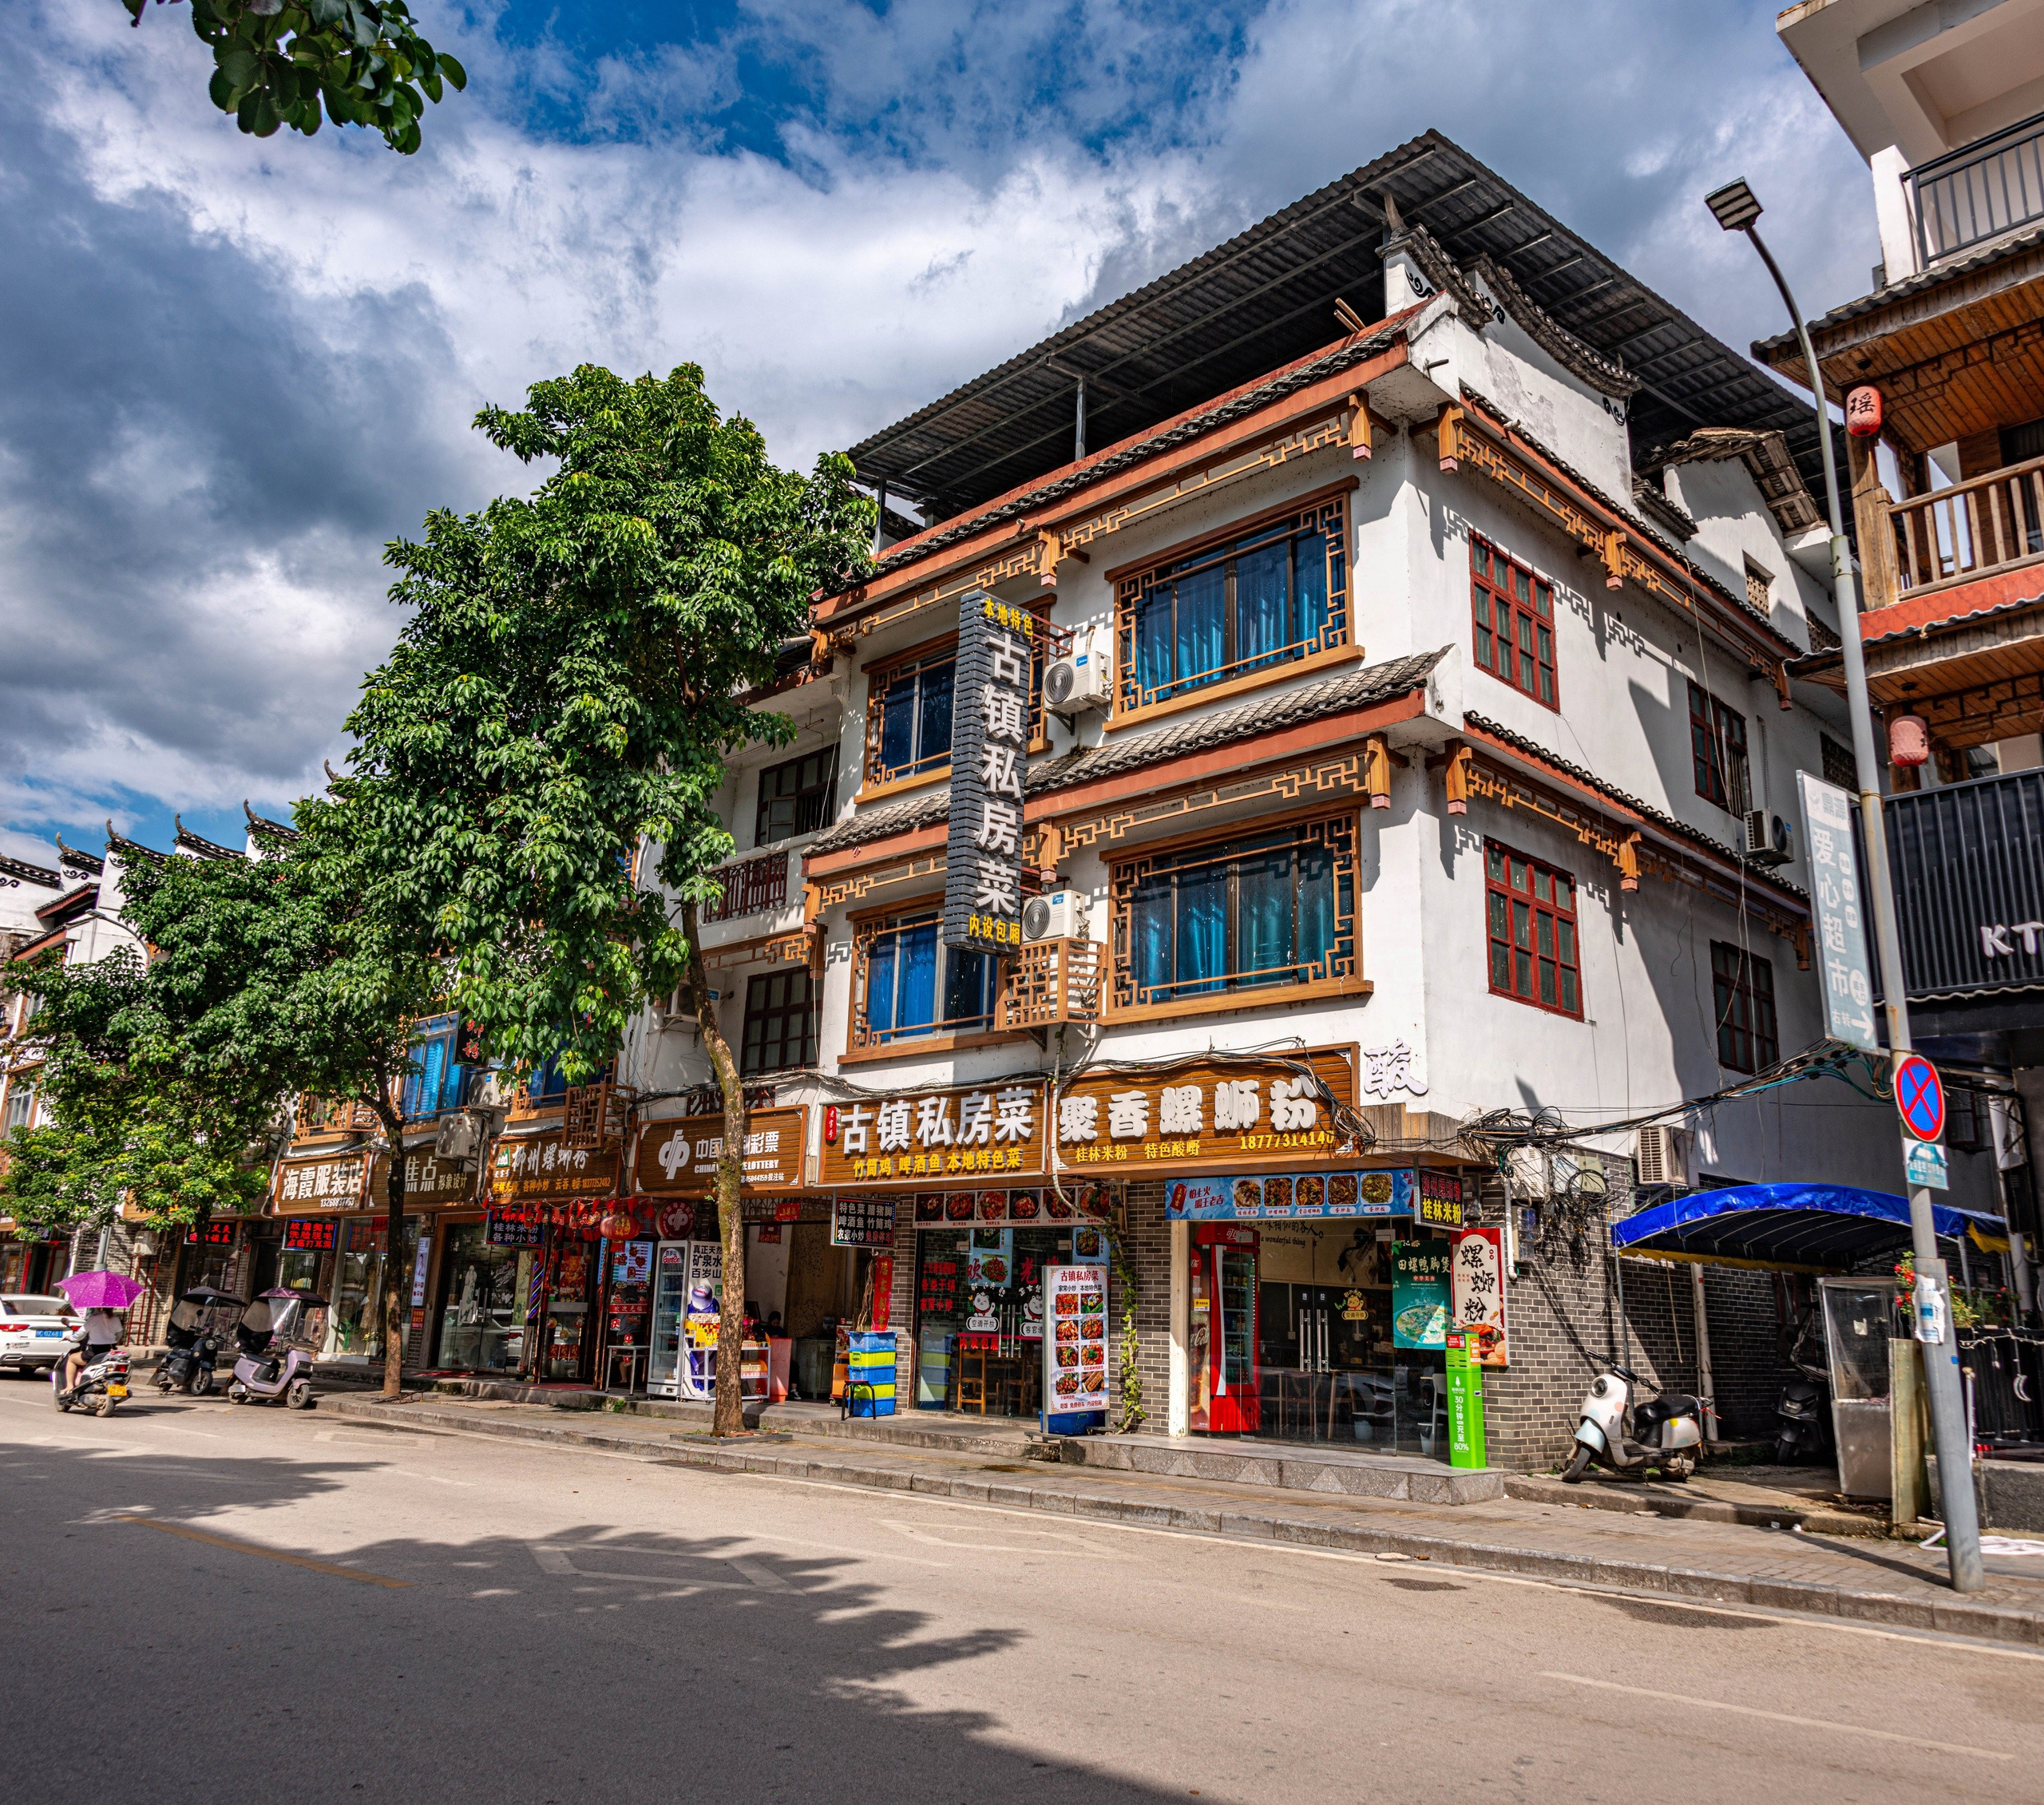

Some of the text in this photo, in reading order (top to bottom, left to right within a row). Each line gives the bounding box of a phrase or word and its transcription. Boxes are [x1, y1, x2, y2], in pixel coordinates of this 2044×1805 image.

[1850, 392, 1876, 415] 瑶
[983, 598, 1034, 636] 本地特色
[976, 634, 1028, 915] 古镇私房菜
[1814, 828, 1849, 997] 爱心超市
[969, 913, 1020, 945] 内设包厢
[1364, 1038, 1428, 1099] 酸
[1059, 1075, 1318, 1143] 聚香螺蛳粉
[840, 1087, 1035, 1154] 古镇私房菜
[695, 1131, 779, 1159] 中国彩票
[1075, 1140, 1200, 1163] 桂林米粉 特色酸嘢
[747, 1159, 779, 1170] LOTTERY
[853, 1147, 1022, 1178] 竹筒鸡 啤酒鱼 本地特色菜
[282, 1160, 364, 1201] 海霞服装店
[389, 1156, 438, 1193] 焦点
[438, 1173, 468, 1190] 形象设计
[1189, 1186, 1211, 1199] 怕上火
[839, 1201, 893, 1217] 特色菜 腊猪脚
[1194, 1194, 1225, 1209] 喝王老吉
[1422, 1198, 1462, 1225] 桂林米粉
[838, 1216, 893, 1230] 啤酒鱼 竹筒鸡
[493, 1233, 537, 1244] 各种小炒
[838, 1228, 865, 1241] 农家小炒
[1266, 1236, 1291, 1246] wonderful
[1292, 1237, 1306, 1248] thing
[693, 1245, 723, 1255] 真正天然
[692, 1254, 723, 1267] 矿泉水
[1398, 1256, 1452, 1273] 田螺鸭脚煲
[691, 1268, 722, 1279] 百岁山
[1060, 1270, 1099, 1281] 古镇私房菜
[1460, 1244, 1495, 1322] 螺蛳粉
[972, 1320, 995, 1328] 空调开放
[1025, 1324, 1043, 1334] 客官请
